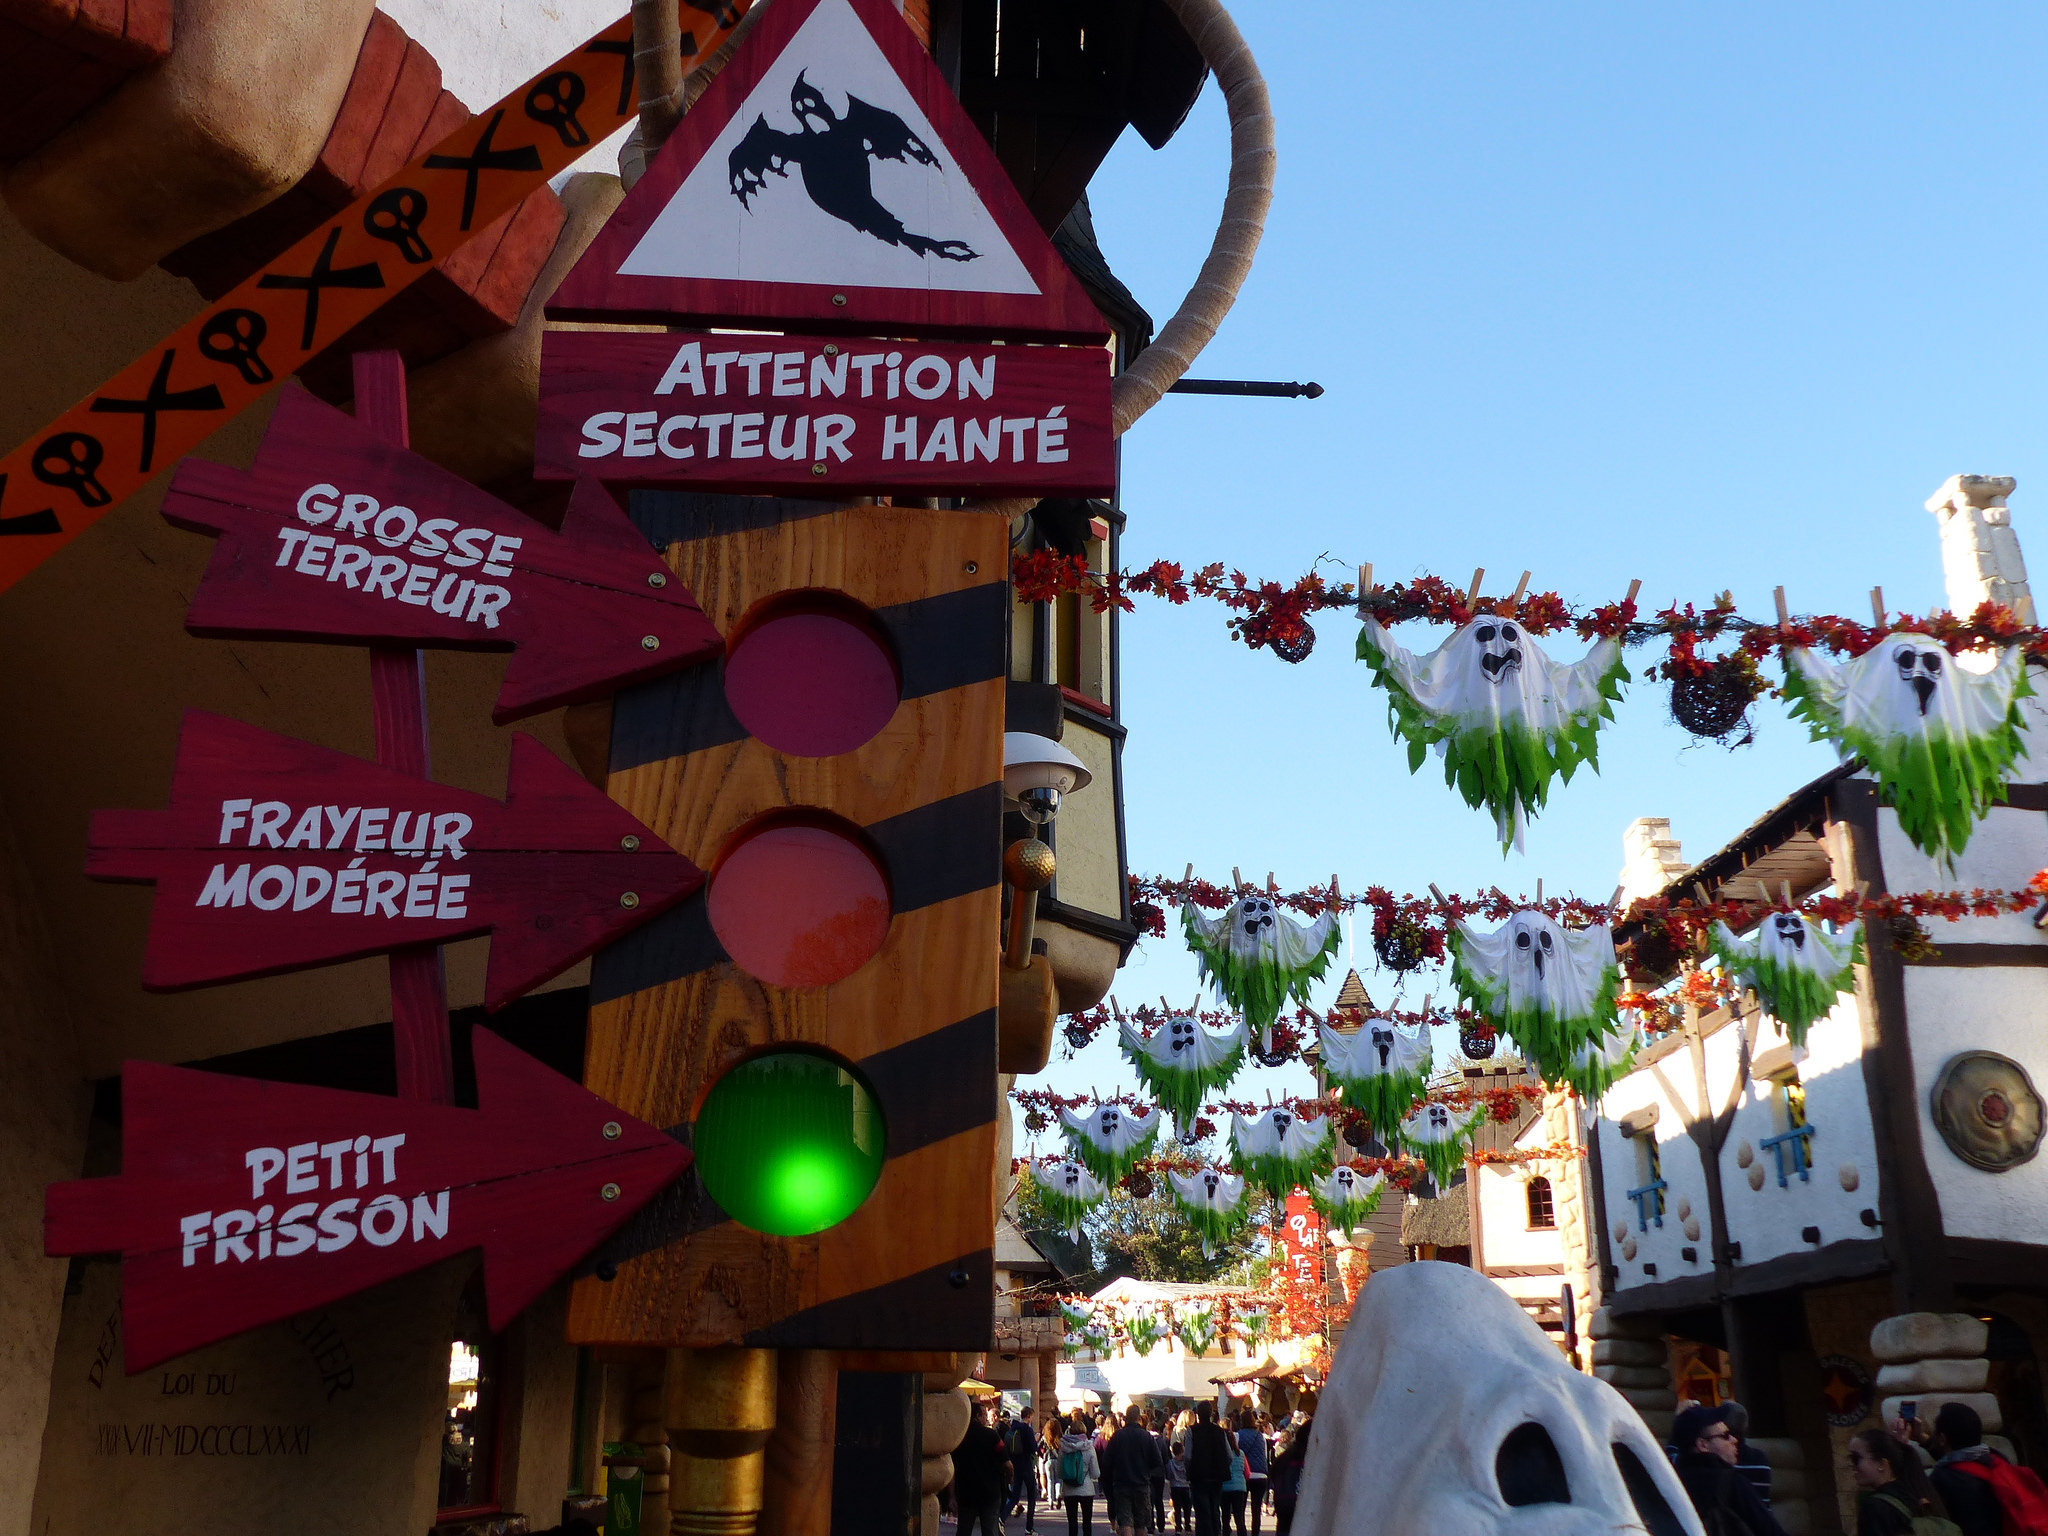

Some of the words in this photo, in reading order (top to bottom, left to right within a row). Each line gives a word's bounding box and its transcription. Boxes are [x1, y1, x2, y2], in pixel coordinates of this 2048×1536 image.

[578, 409, 857, 464] SECTEUR
[881, 404, 1070, 464] HANTÉ
[296, 483, 523, 578] GROSSE
[275, 526, 512, 629] TERREUR
[218, 798, 474, 861] FRAYEUR
[195, 856, 471, 920] MODÉRÉE
[245, 1133, 406, 1201] PETIT
[180, 1186, 451, 1268] FRISSON
[161, 1372, 196, 1396] LOI
[205, 1373, 238, 1396] DU
